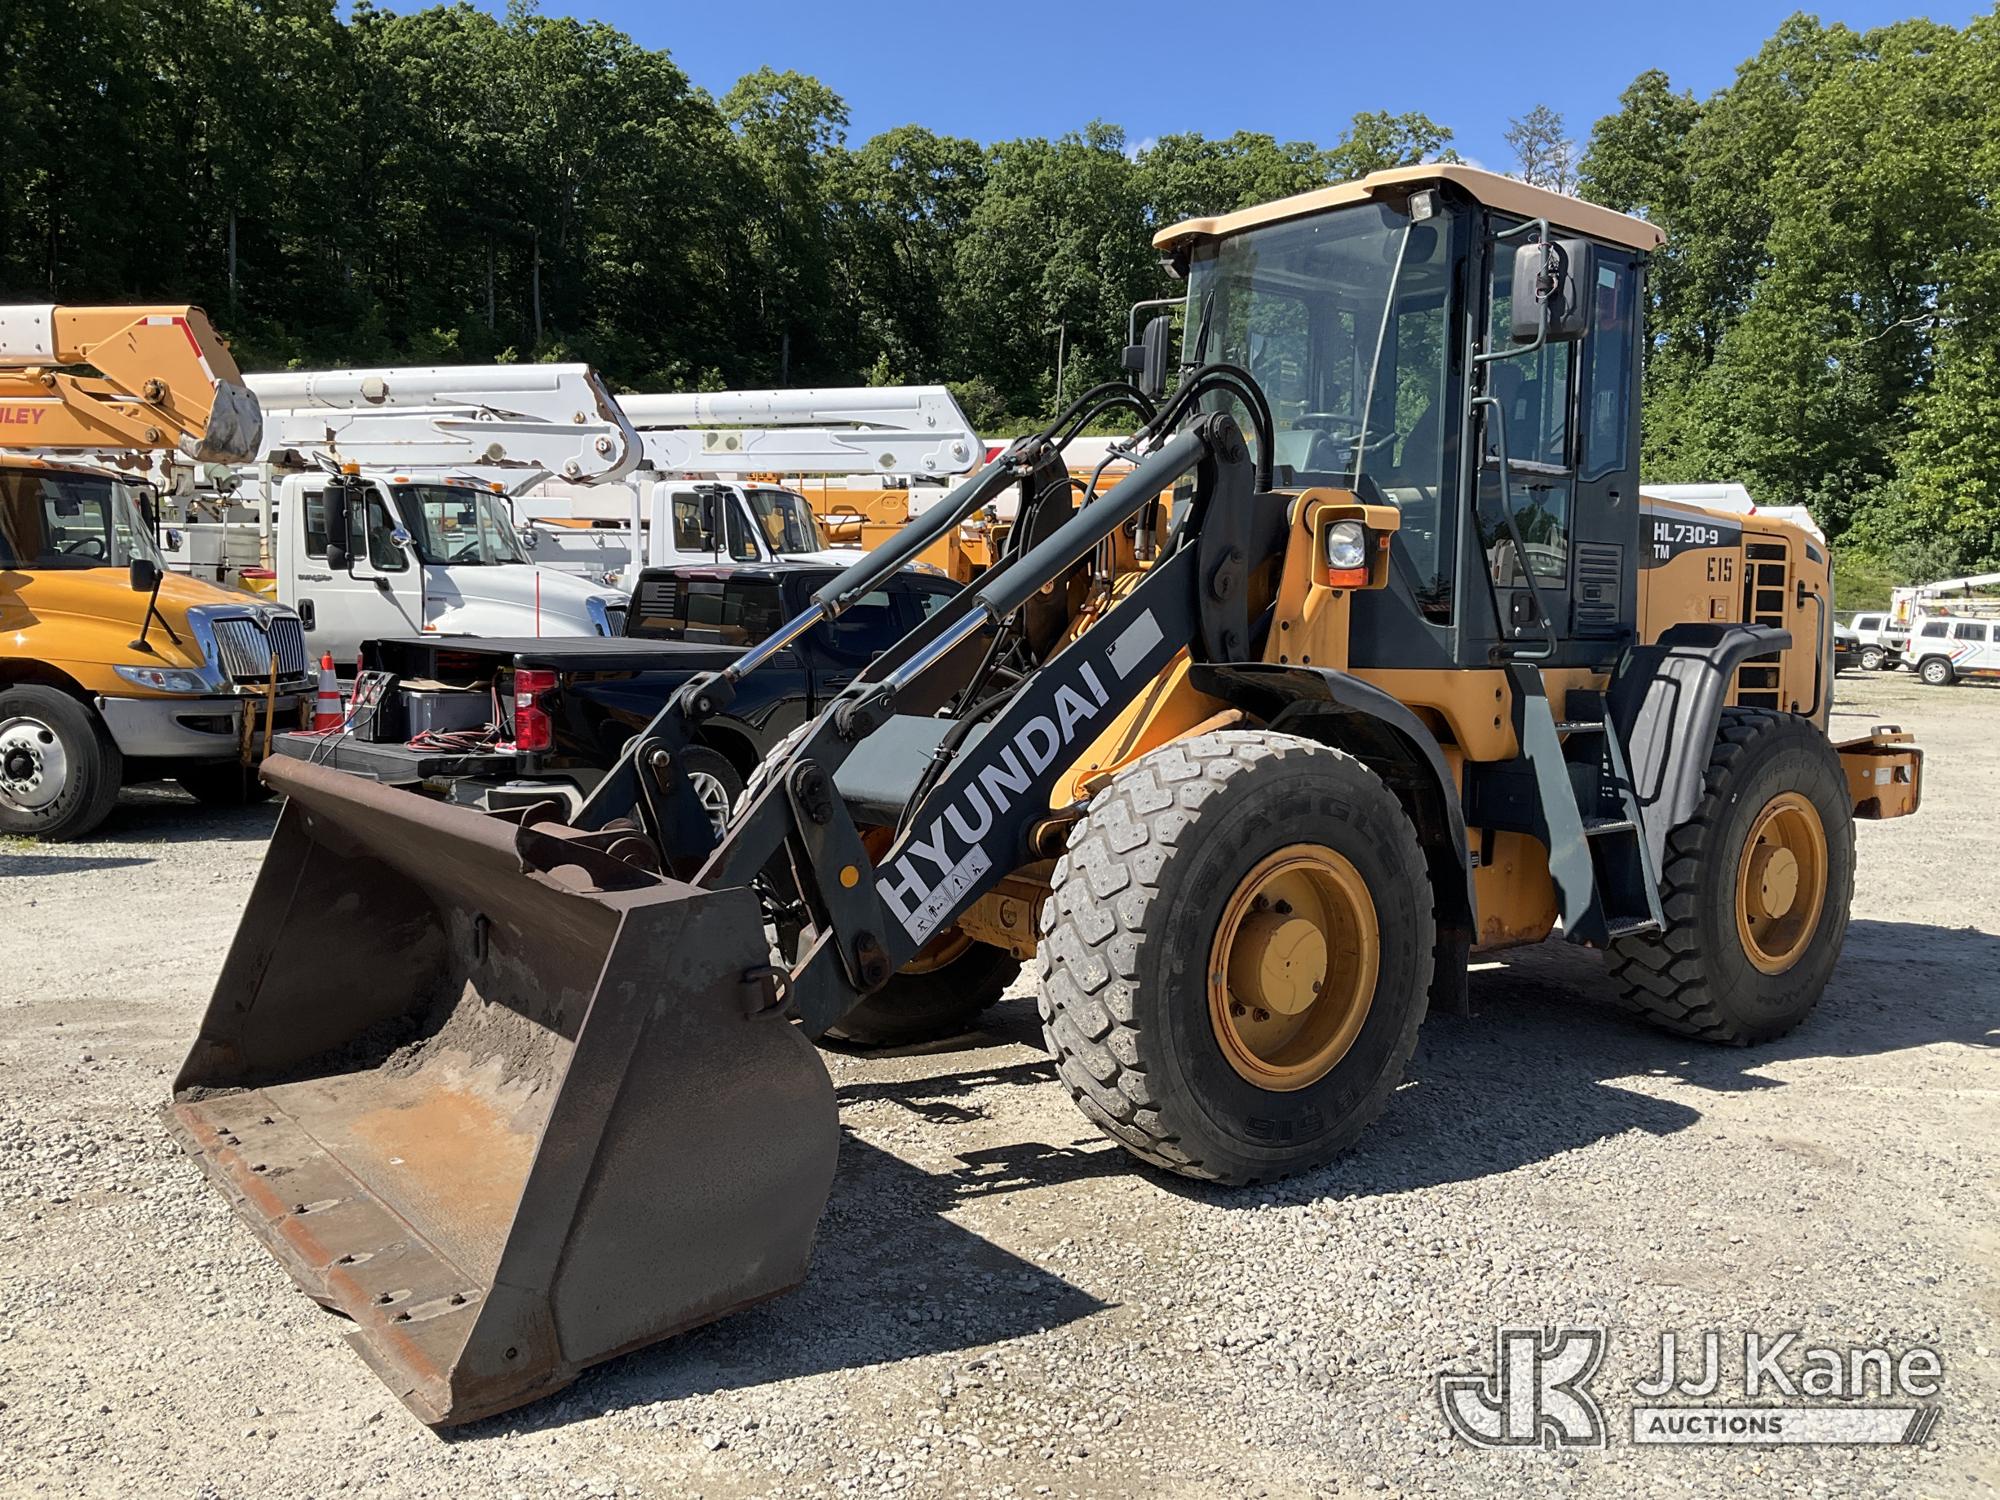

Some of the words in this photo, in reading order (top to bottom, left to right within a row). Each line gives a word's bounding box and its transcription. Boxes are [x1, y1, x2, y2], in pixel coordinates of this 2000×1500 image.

[1653, 522, 1719, 545] HL730-9
[1653, 544, 1670, 559] TM
[876, 661, 1110, 920] HYUNDAI
